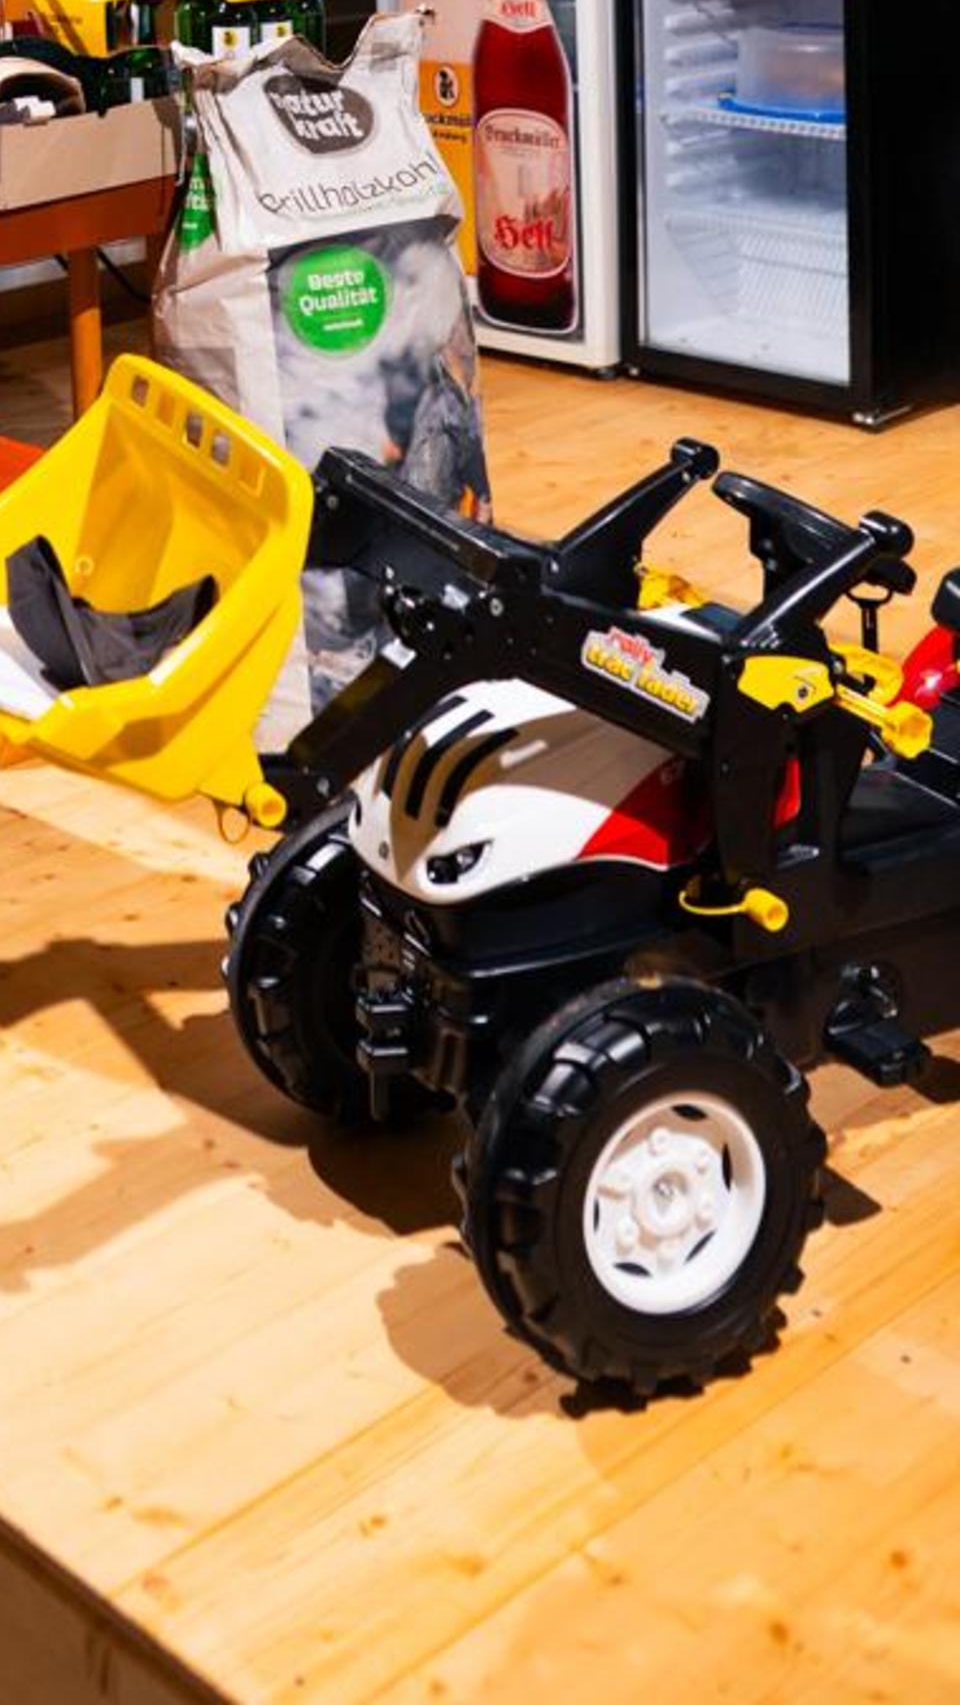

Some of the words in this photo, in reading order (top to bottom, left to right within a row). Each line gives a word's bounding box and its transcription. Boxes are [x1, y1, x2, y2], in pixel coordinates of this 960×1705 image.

[289, 111, 363, 140] kraft
[308, 271, 364, 290] Beste
[299, 287, 378, 316] Qualität
